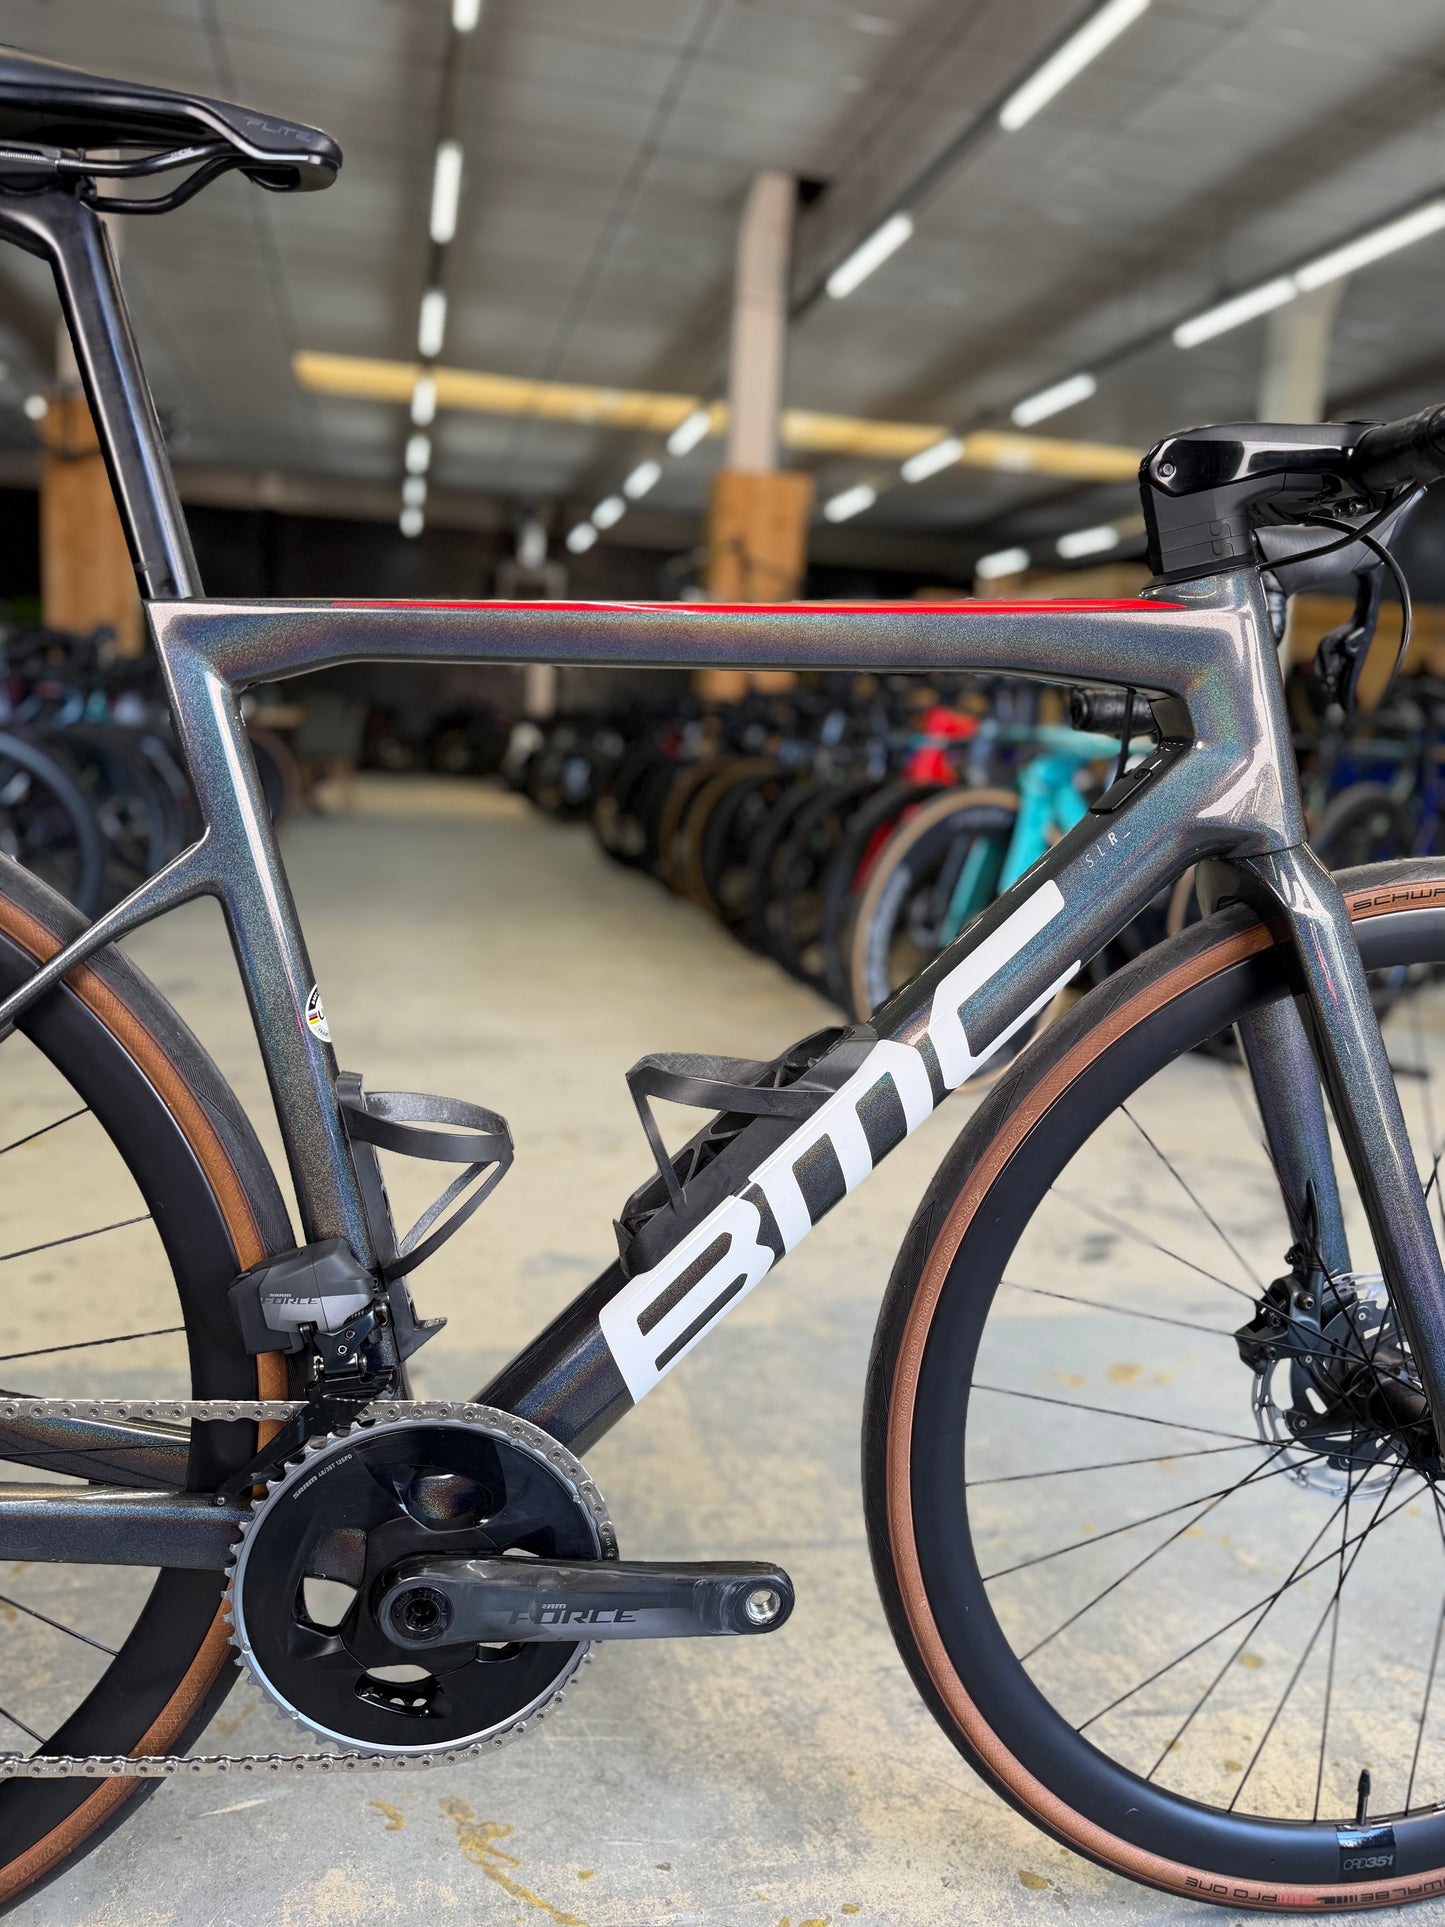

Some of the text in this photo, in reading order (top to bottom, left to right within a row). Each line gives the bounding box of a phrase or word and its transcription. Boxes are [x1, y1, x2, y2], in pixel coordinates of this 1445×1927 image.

[261, 1297, 318, 1305] FORCE
[293, 1475, 318, 1500] SRAM
[508, 1608, 637, 1625] FORCE
